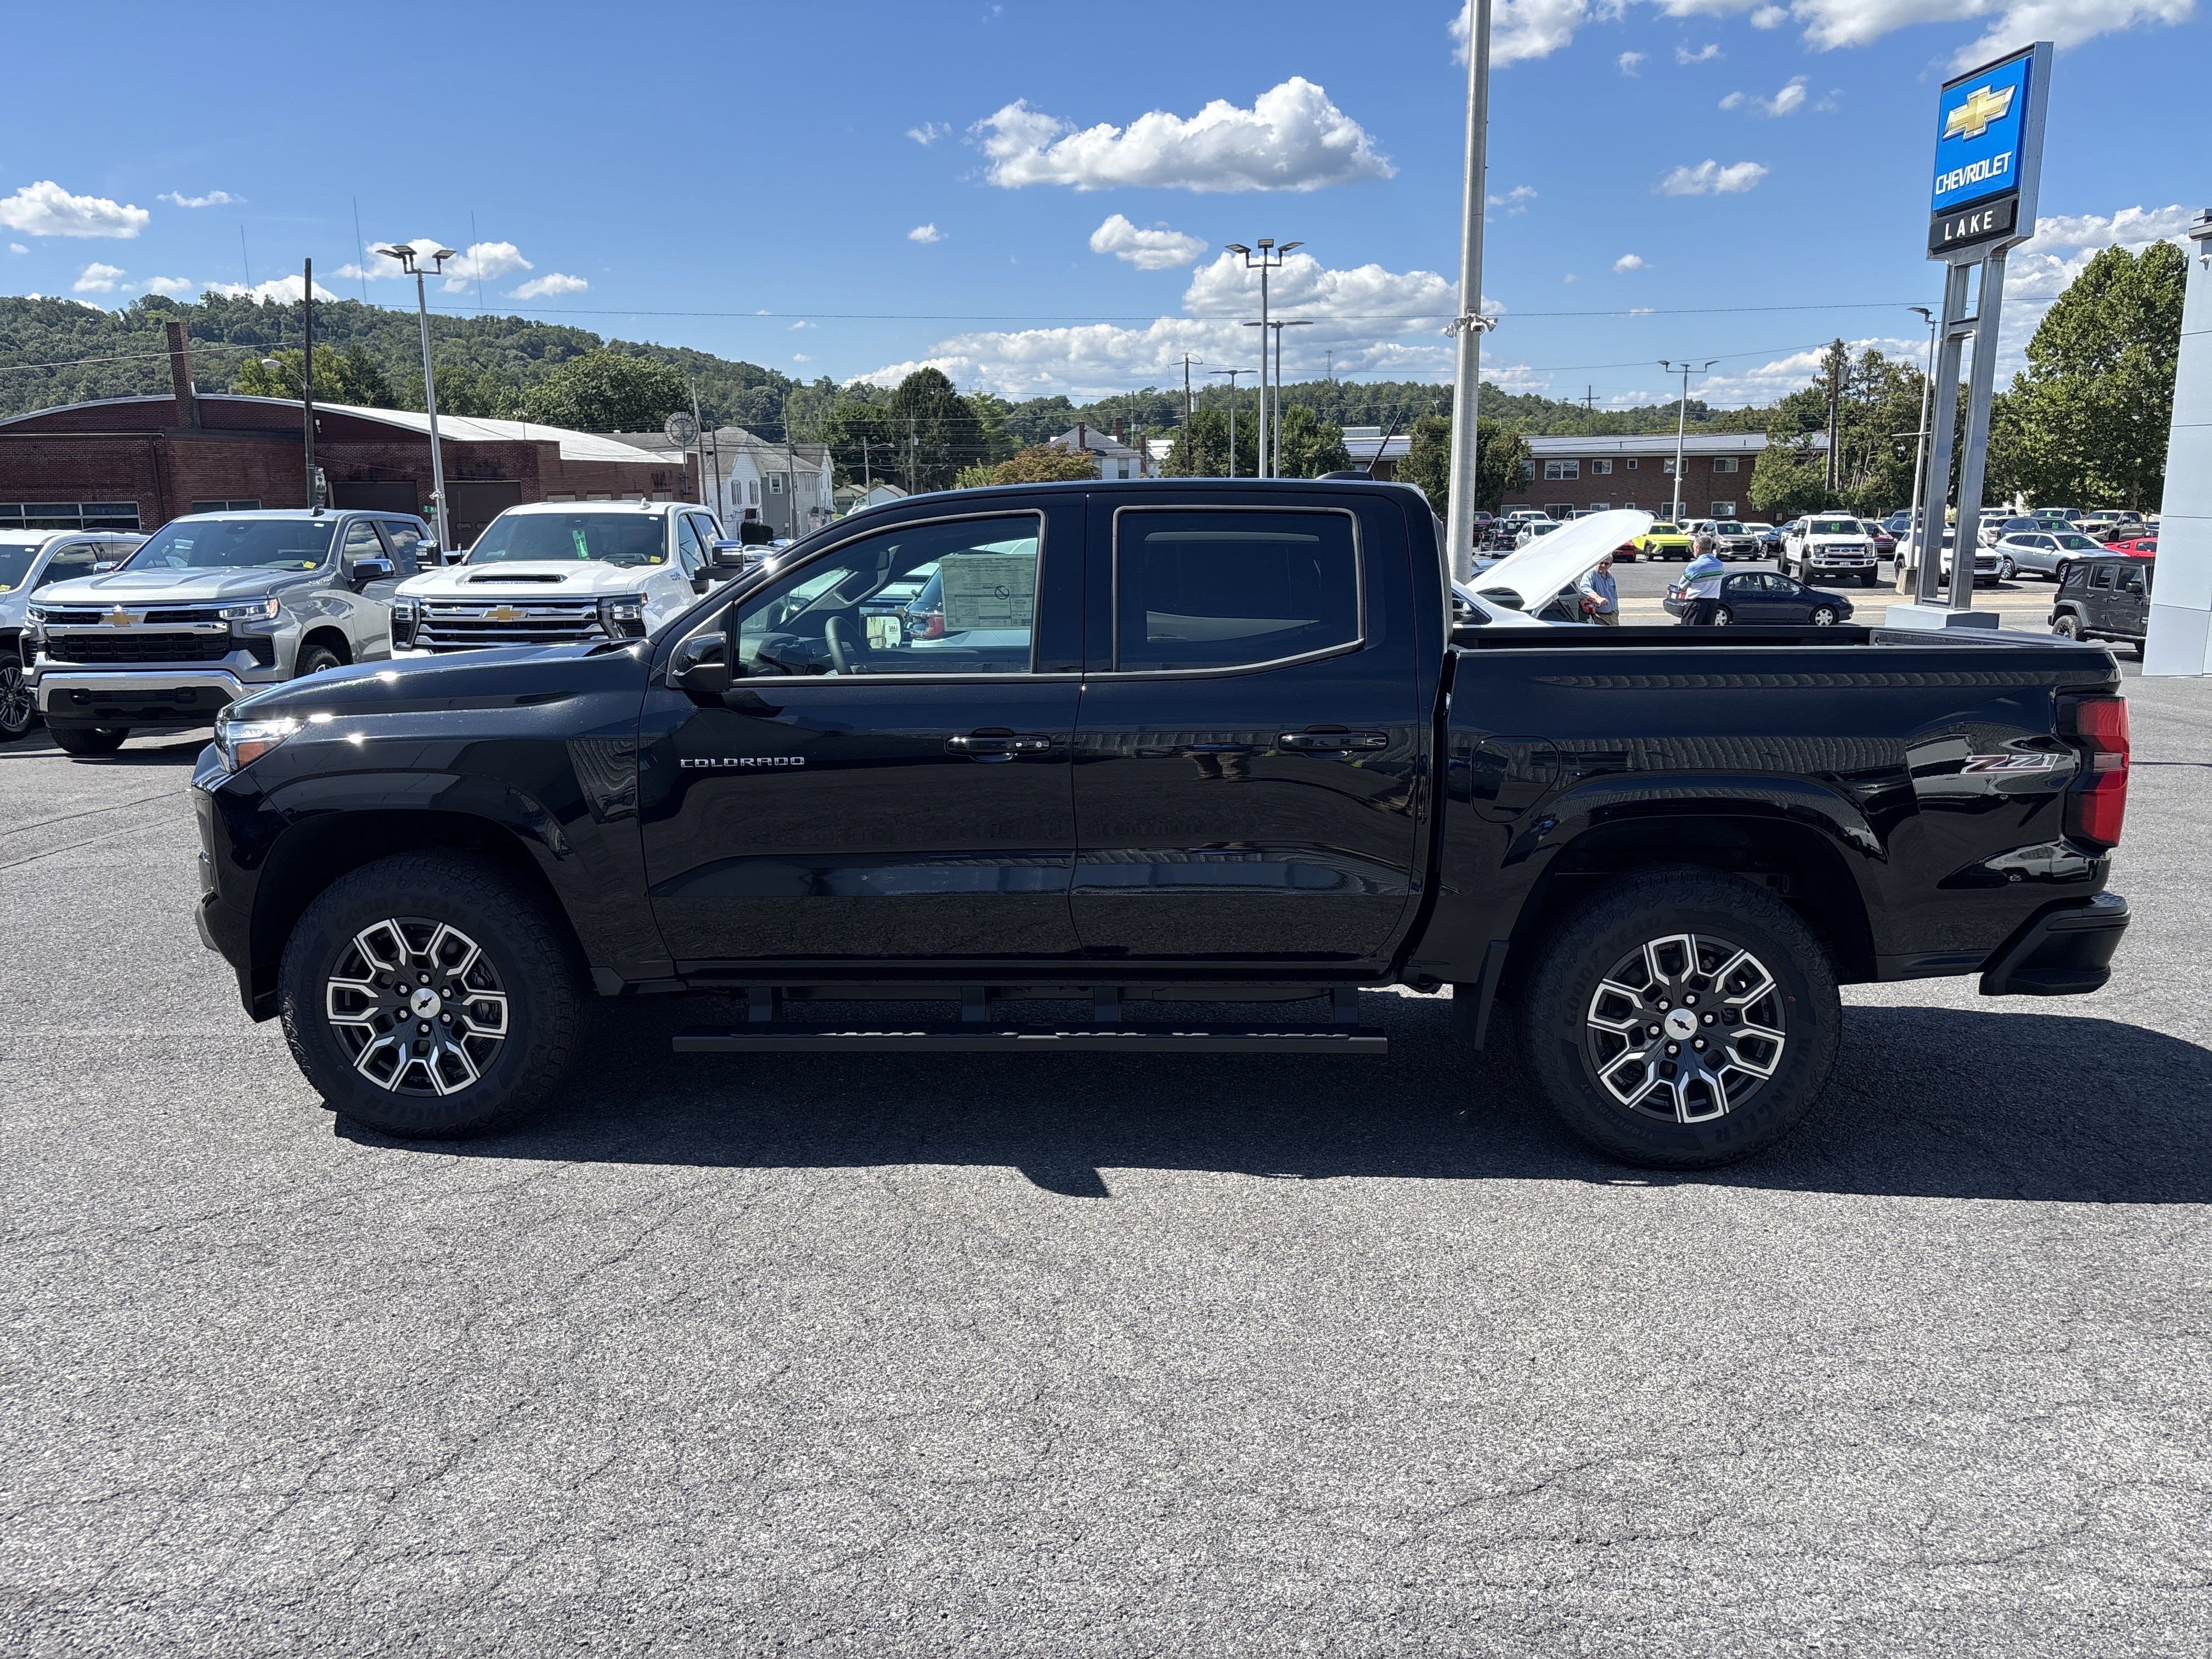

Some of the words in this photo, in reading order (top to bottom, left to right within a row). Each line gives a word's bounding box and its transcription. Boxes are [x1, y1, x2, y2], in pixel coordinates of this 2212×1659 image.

[1936, 151, 2012, 195] CHEVROLET
[1944, 210, 1994, 241] LAKE
[680, 757, 805, 768] COLORADO
[1960, 754, 2059, 775] Z71
[1716, 1039, 1812, 1142] WRANGLER
[1593, 1100, 1655, 1141] TERRITORY
